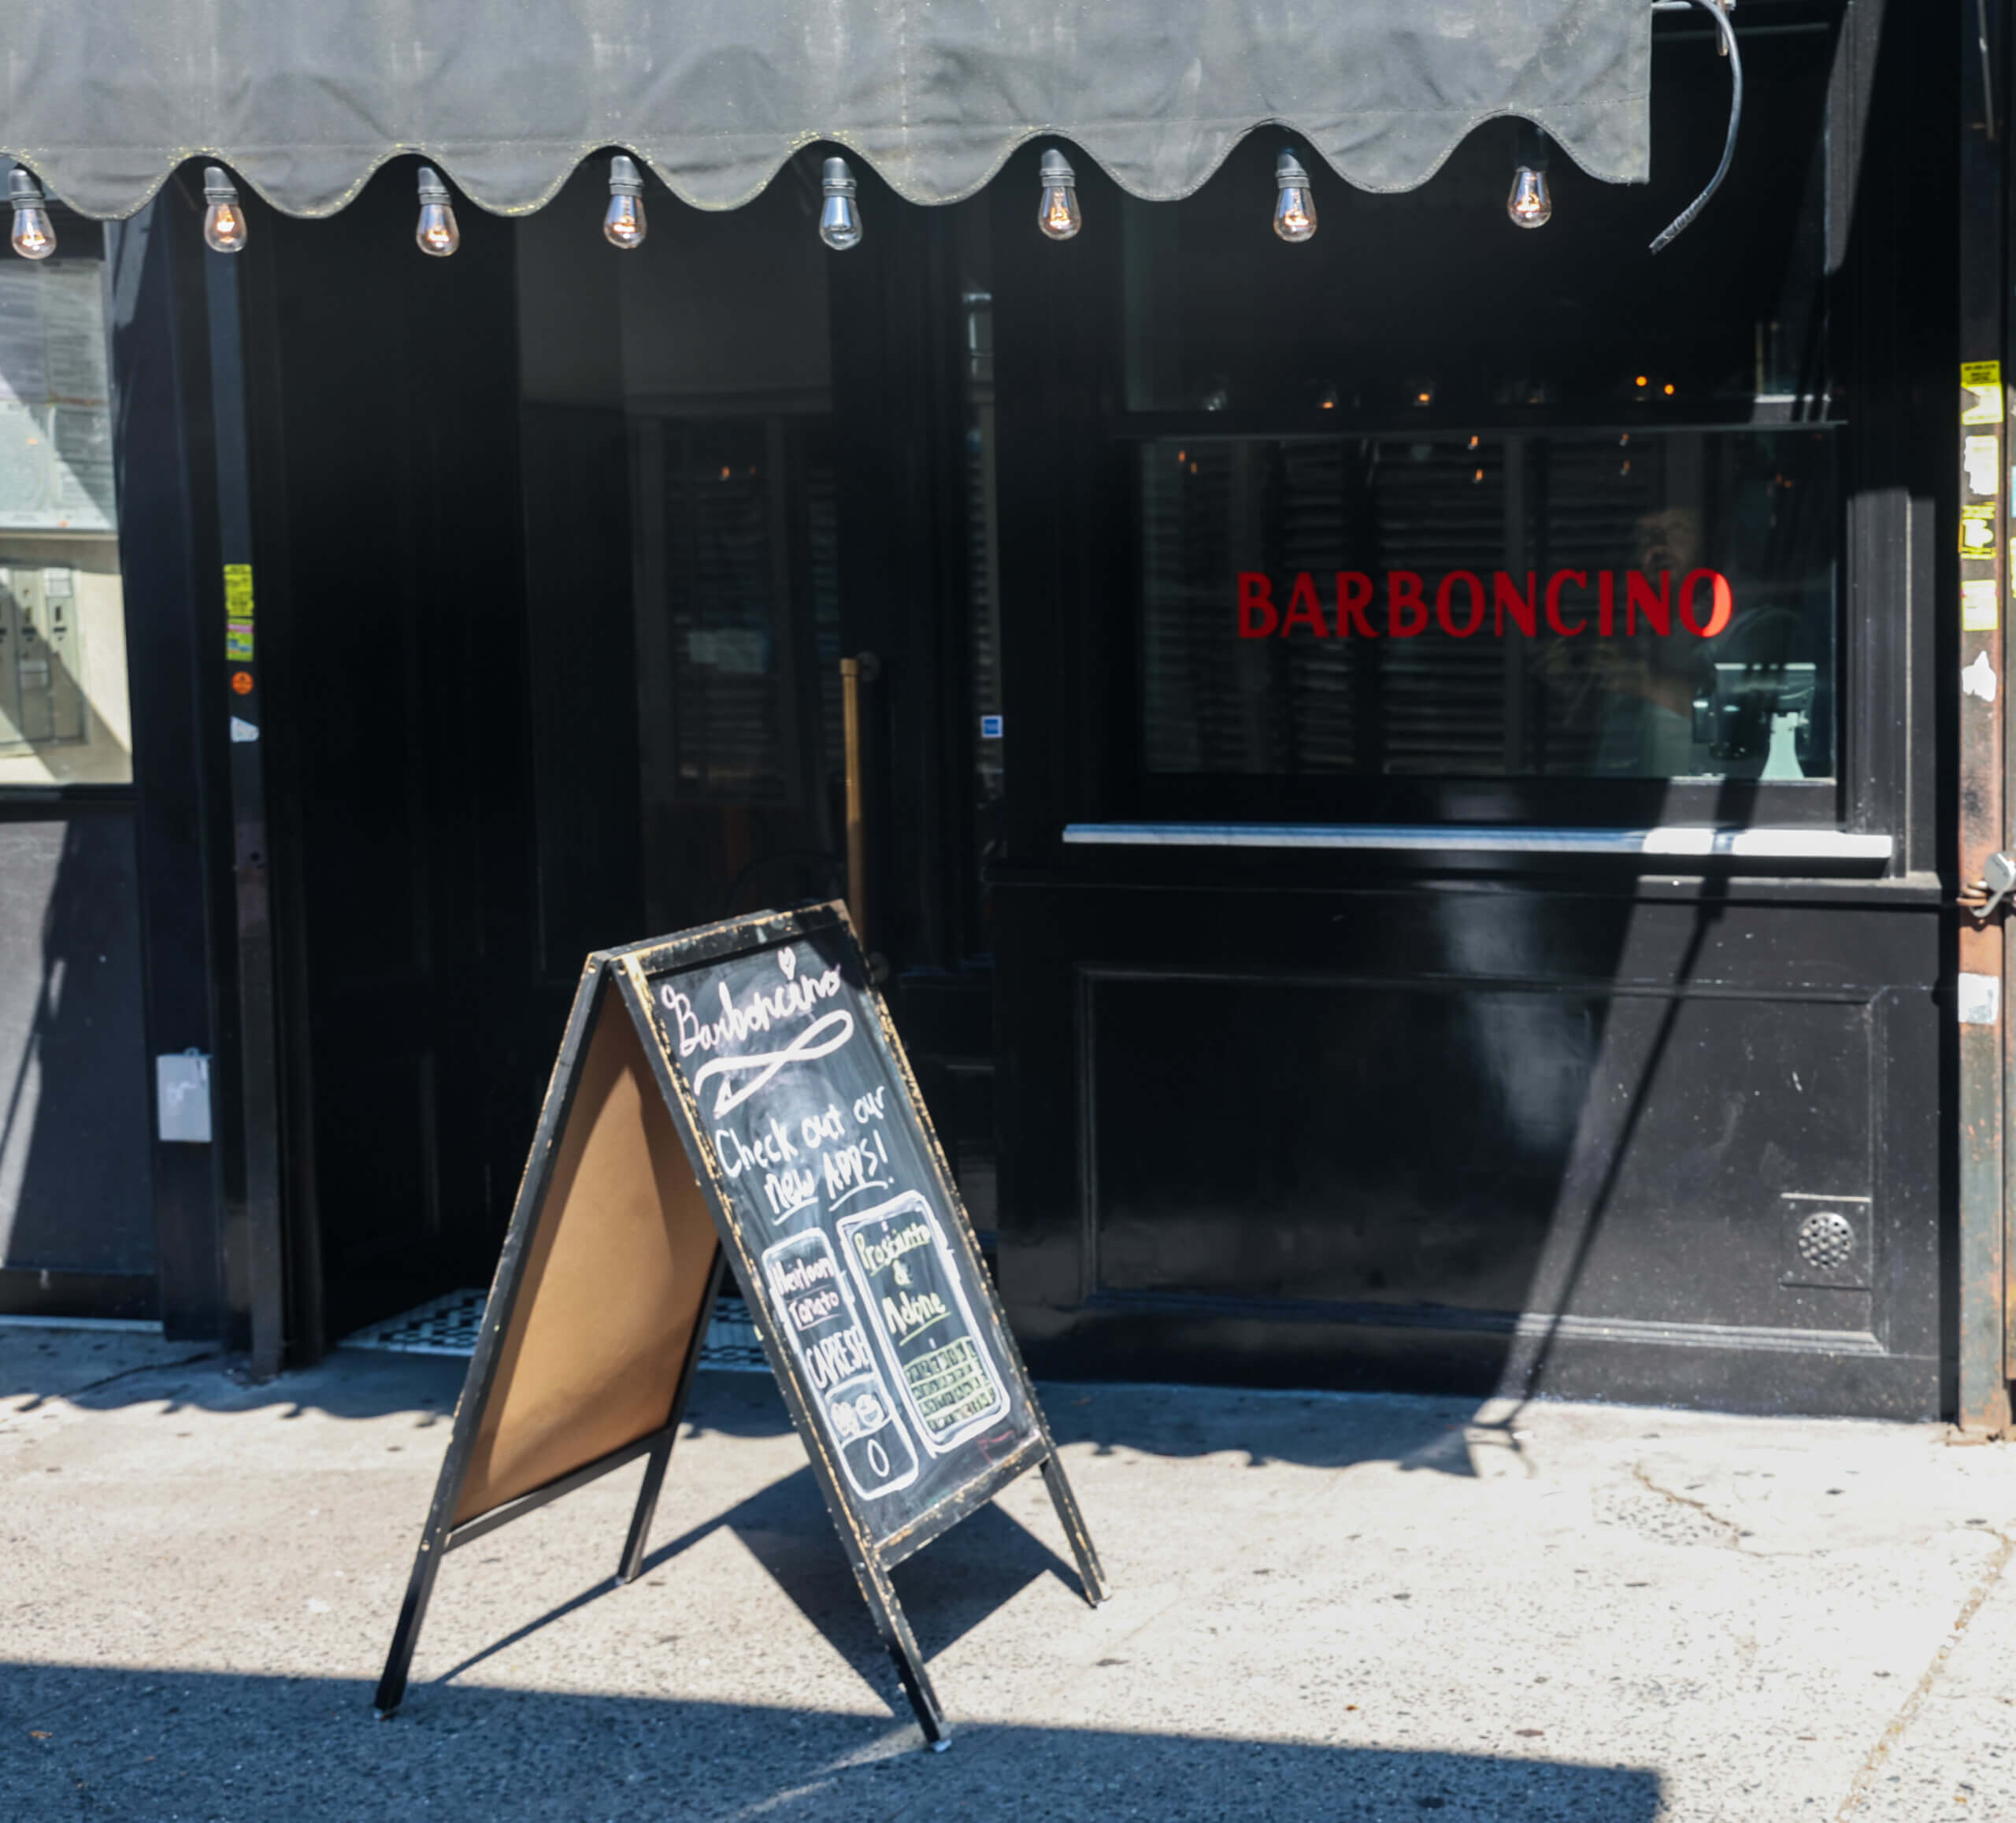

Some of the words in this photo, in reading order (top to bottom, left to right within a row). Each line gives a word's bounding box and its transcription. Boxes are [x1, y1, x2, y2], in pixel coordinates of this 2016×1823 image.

[1236, 567, 1733, 639] BARBONCINO
[662, 947, 842, 1057] Barboncino
[714, 1120, 800, 1178] Check
[801, 1104, 843, 1150] out
[853, 1085, 888, 1124] our
